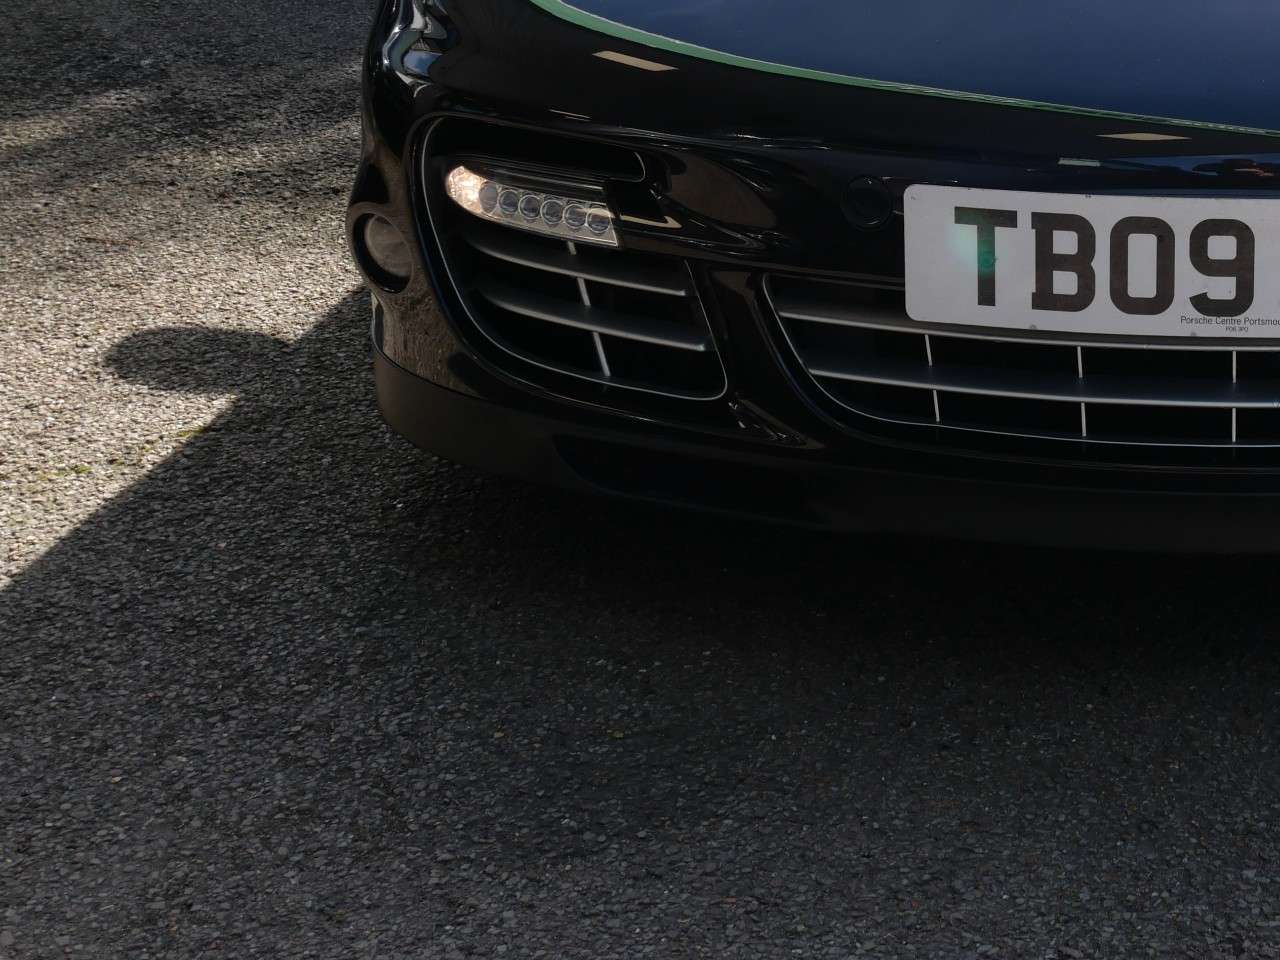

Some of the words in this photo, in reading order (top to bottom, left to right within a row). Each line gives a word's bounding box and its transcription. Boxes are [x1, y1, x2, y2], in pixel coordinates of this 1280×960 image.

[954, 206, 1256, 318] TB09
[1180, 316, 1213, 325] Porsche
[1215, 317, 1242, 325] Centre
